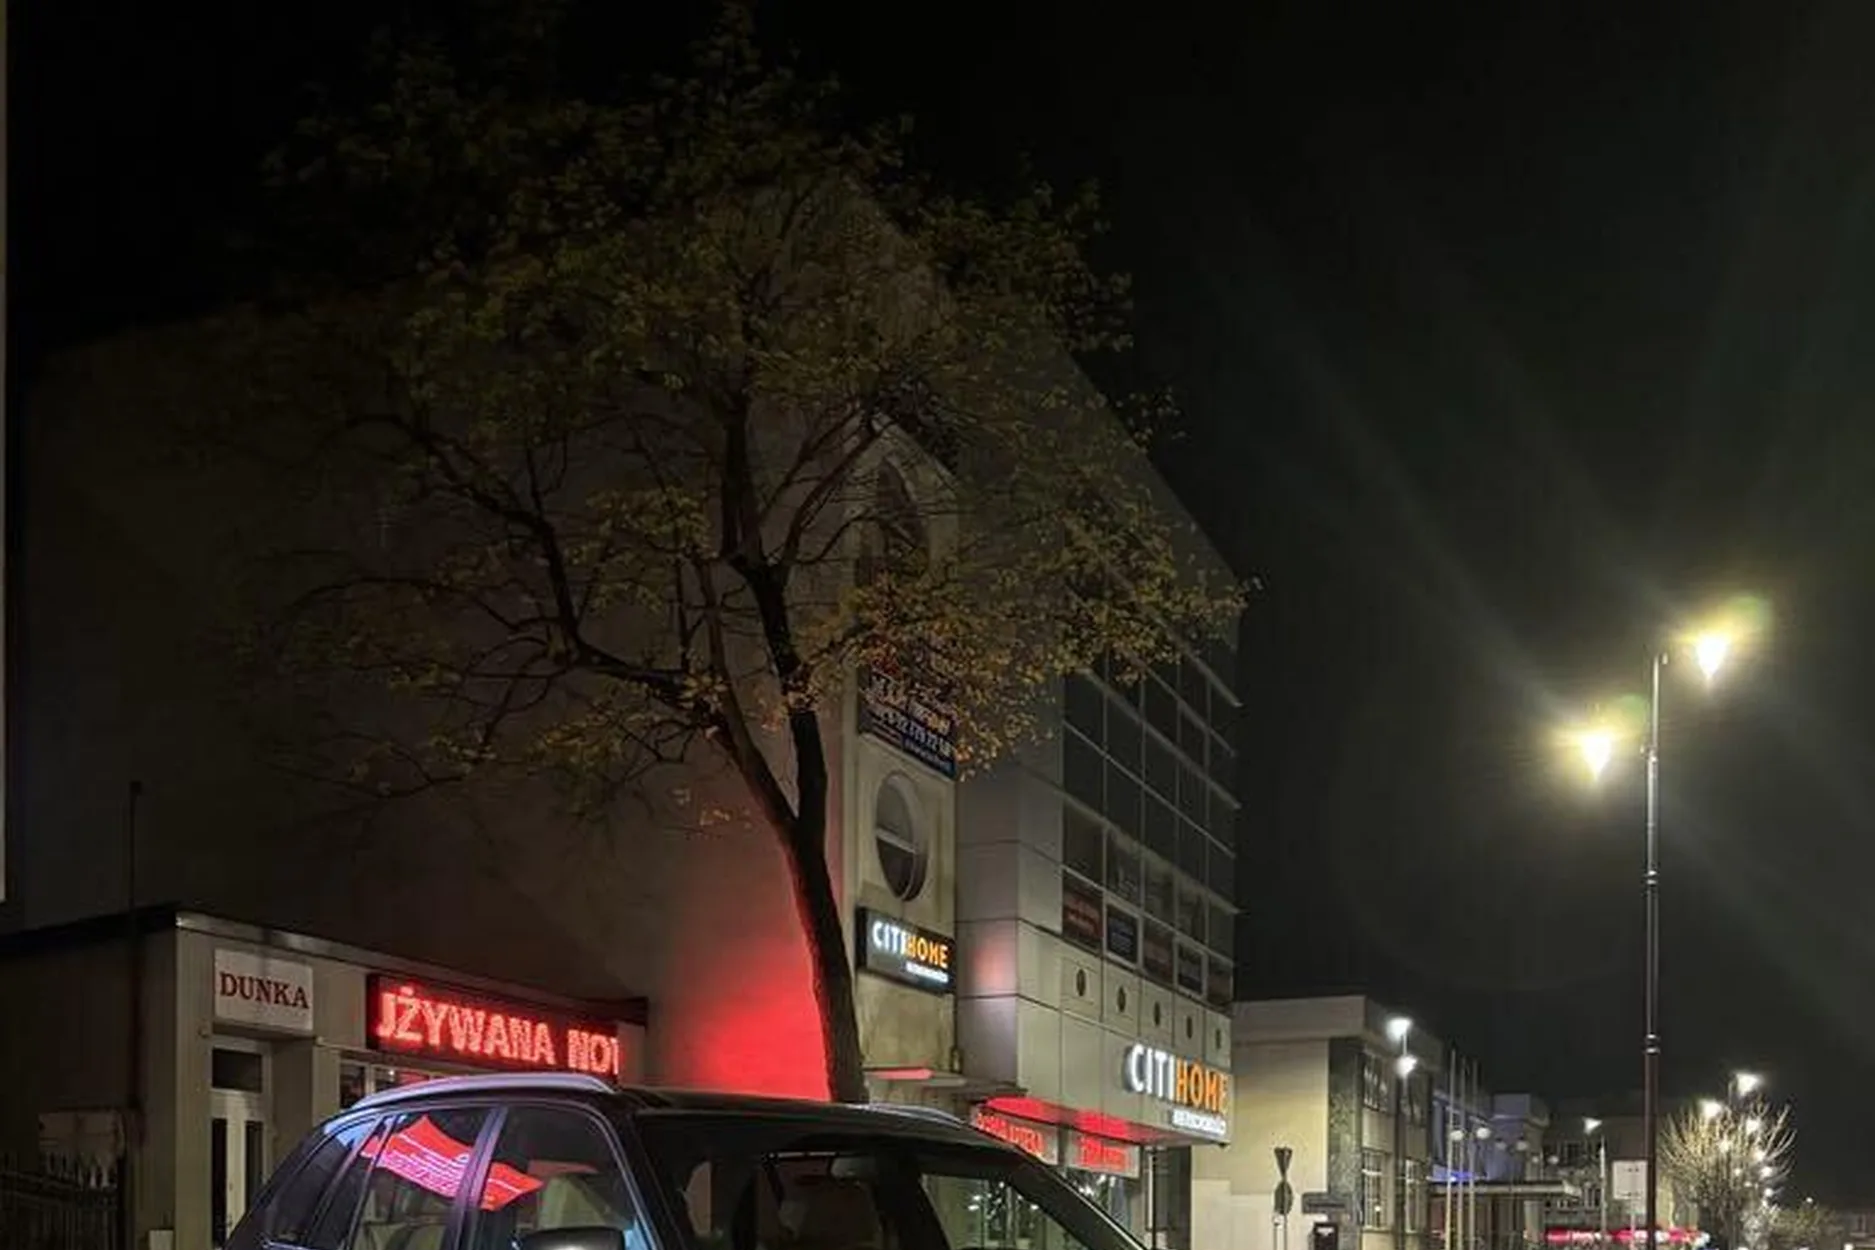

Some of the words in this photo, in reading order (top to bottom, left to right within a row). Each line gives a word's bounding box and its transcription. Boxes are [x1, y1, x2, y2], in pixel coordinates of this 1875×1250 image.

[872, 920, 948, 969] CITIHOME
[219, 971, 309, 1010] DUNKA
[1131, 1043, 1229, 1116] CITIHOME
